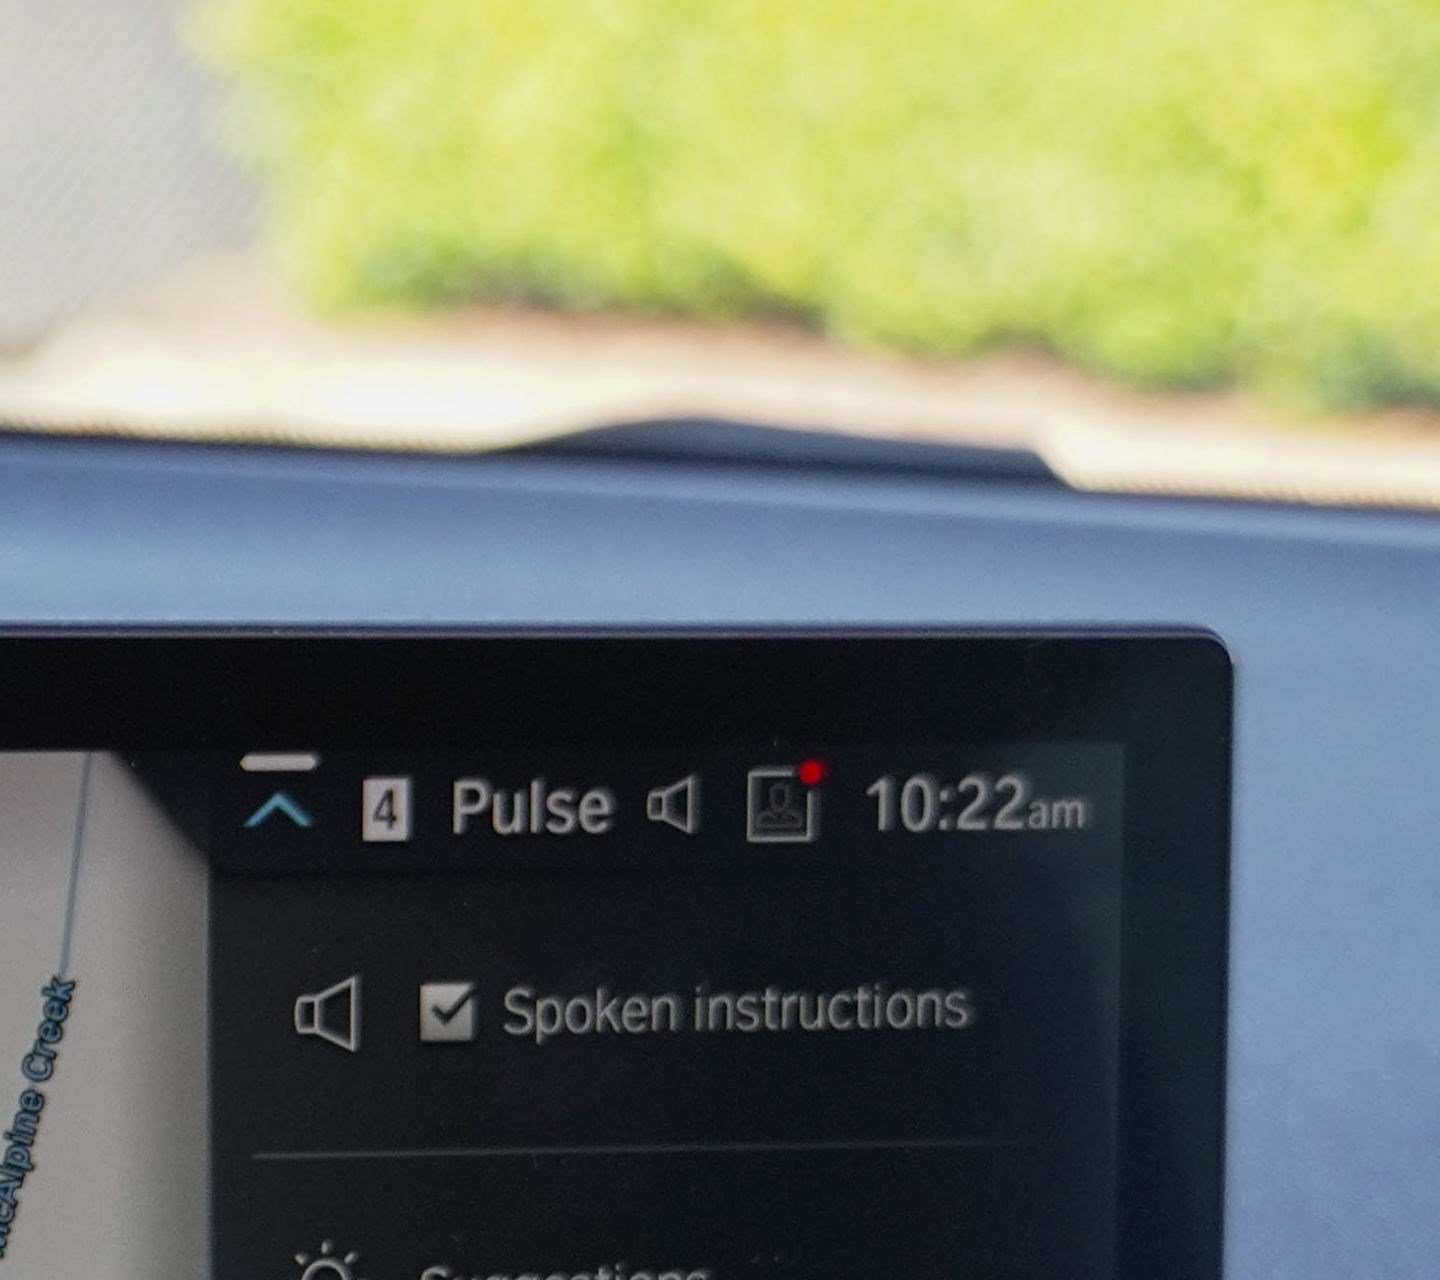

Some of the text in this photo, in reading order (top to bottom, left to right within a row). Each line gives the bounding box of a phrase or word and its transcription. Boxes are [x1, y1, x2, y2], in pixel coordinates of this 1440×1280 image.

[372, 775, 1086, 835] 4 Pulse 10:22am
[20, 975, 76, 1083] Creek
[502, 983, 975, 1044] Spoken instructions
